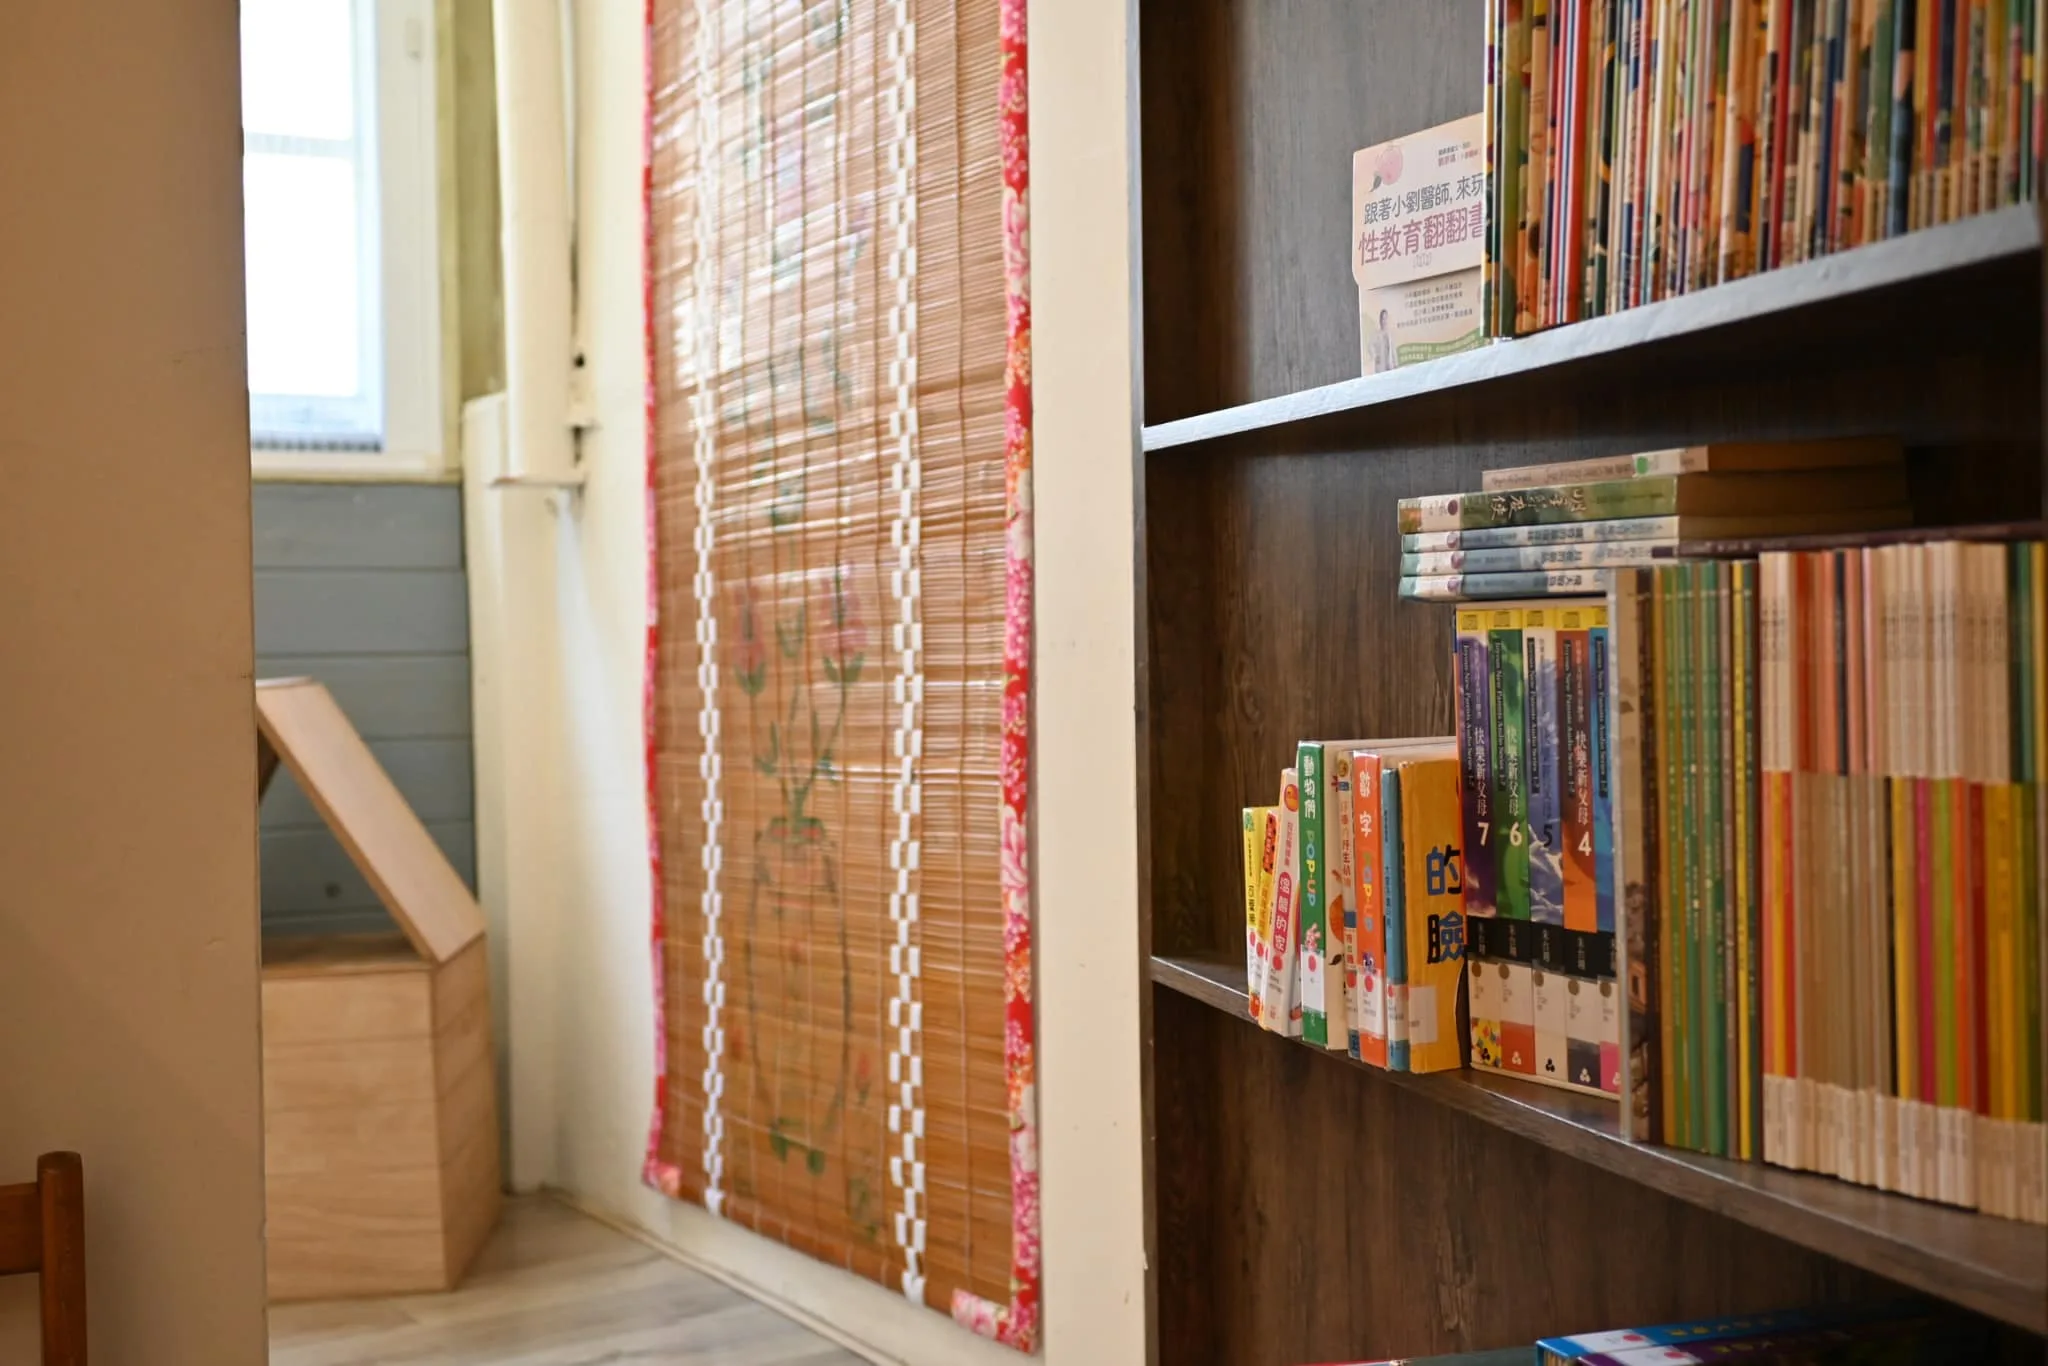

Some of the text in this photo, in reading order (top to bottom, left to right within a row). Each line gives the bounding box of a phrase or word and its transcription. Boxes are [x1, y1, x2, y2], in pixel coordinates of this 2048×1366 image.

[1358, 200, 1484, 266] 性教育翻翻書
[1303, 755, 1317, 820] 動物們
[1474, 727, 1488, 817] 快樂新父母
[1575, 729, 1588, 825] 快樂新父母
[1477, 822, 1489, 846] 7
[1509, 821, 1522, 846] 6
[1543, 824, 1553, 847] 5
[1578, 831, 1592, 856] 4
[1305, 830, 1317, 906] POP-UP
[1361, 850, 1375, 932] POP-UP
[1426, 844, 1464, 964] 的臉
